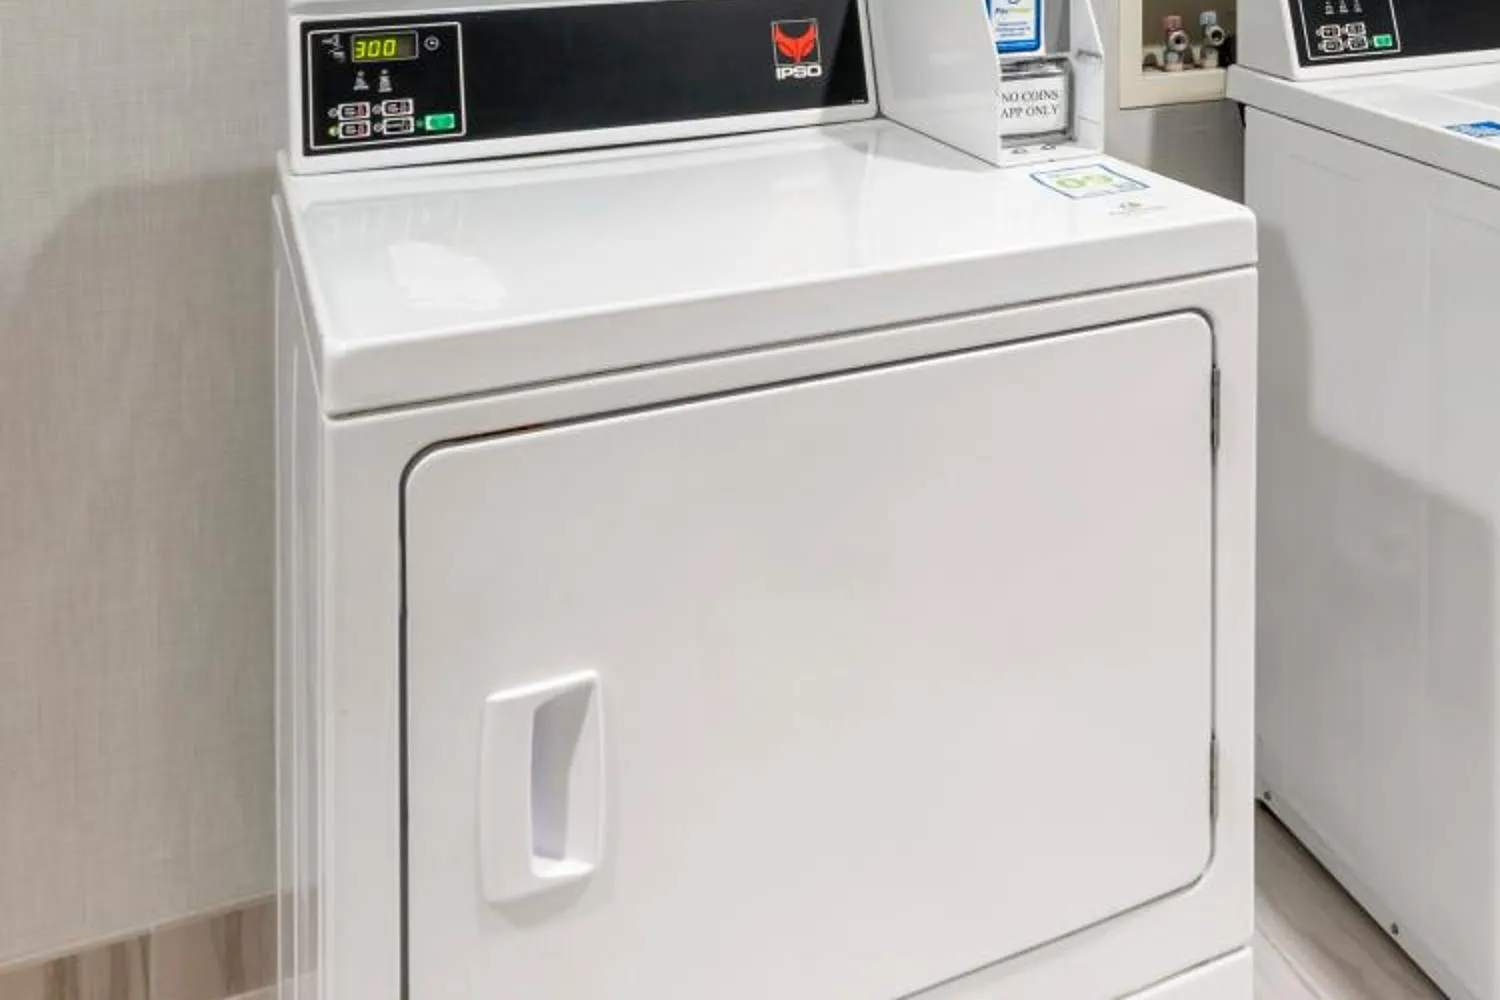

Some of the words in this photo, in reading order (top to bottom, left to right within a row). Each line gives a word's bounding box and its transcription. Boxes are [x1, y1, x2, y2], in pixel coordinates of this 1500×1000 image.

[355, 38, 397, 59] 300
[775, 64, 823, 80] IPSO
[1001, 91, 1019, 102] NO
[1021, 88, 1059, 102] COINS
[1000, 107, 1023, 119] APP
[1025, 103, 1059, 118] ONLY
